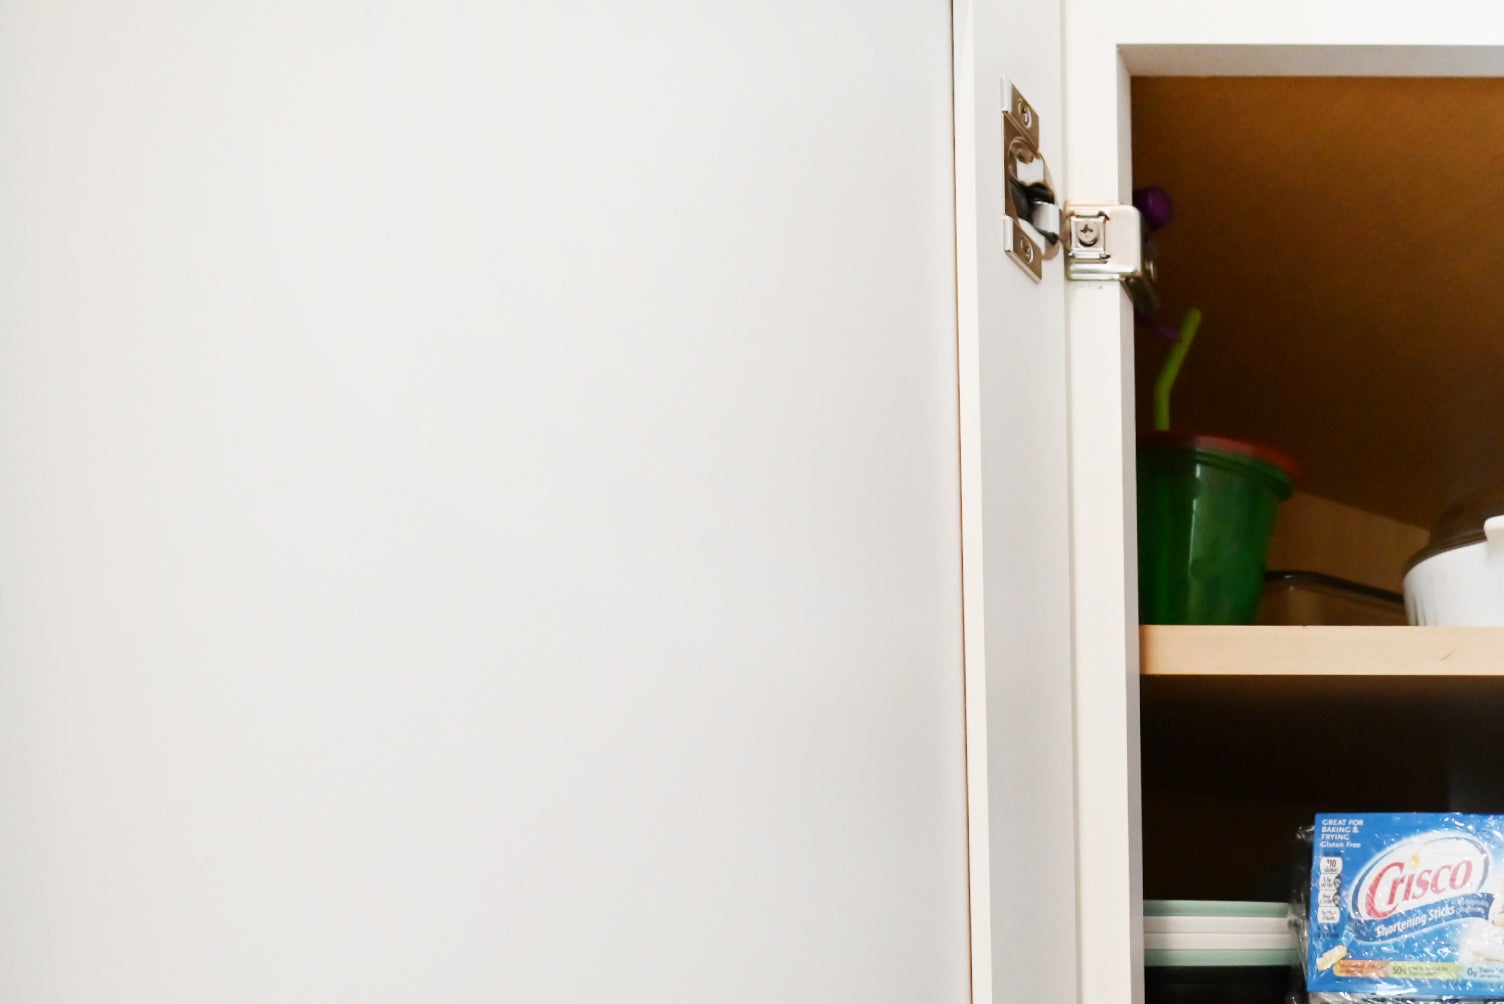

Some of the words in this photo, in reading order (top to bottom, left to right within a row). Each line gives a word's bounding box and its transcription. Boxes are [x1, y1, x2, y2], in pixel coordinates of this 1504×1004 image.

[1321, 833, 1350, 841] FRYING
[1365, 860, 1473, 919] Crisco
[1376, 913, 1427, 938] Shortening
[1428, 904, 1455, 921] Sticks
